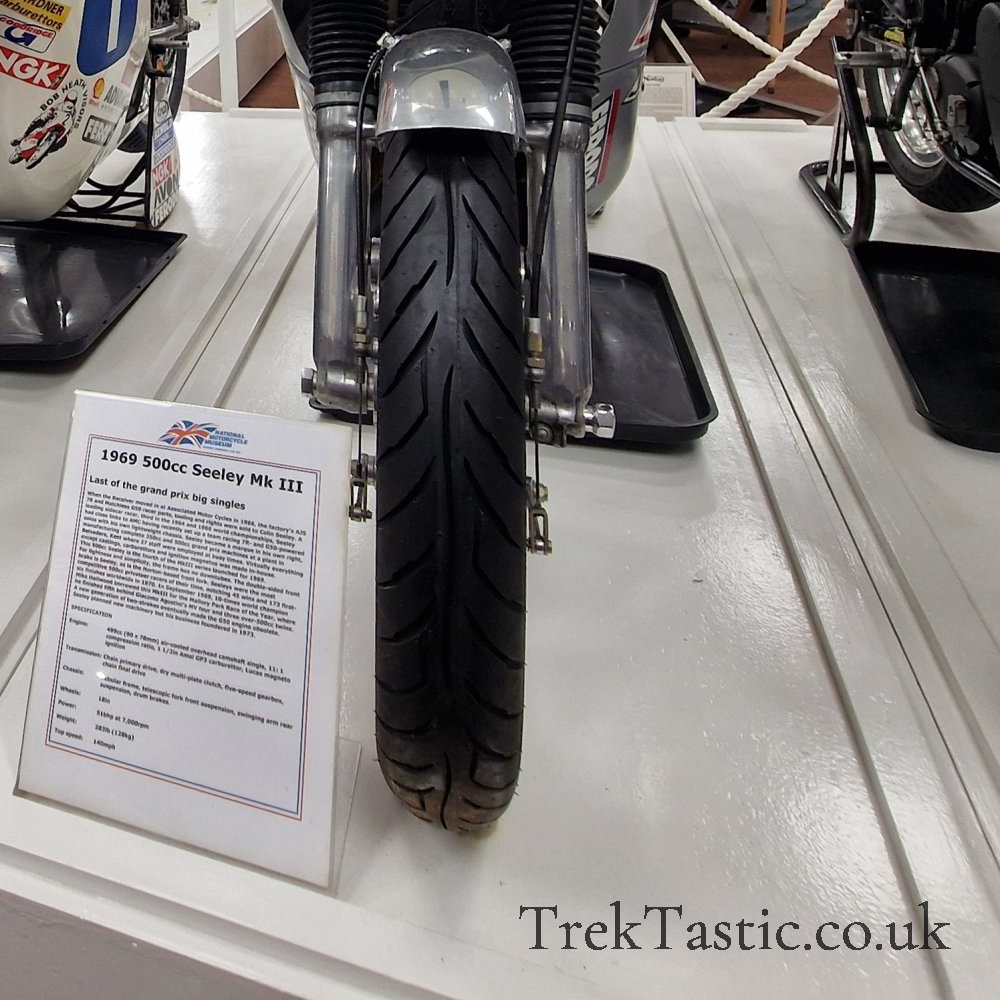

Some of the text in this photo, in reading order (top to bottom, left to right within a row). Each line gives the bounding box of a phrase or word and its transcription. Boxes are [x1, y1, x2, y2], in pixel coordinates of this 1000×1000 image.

[0, 16, 54, 38] GOODRIDGE
[40, 92, 60, 112] BOB
[61, 78, 87, 93] HEATH
[74, 90, 88, 129] VISORS
[204, 440, 232, 448] MUSEUM
[215, 430, 245, 439] NATIONAL
[101, 448, 302, 493] 1969 500cc Seeley Mk III
[89, 475, 245, 512] Last of the grand prix big singles
[103, 675, 121, 684] ubular
